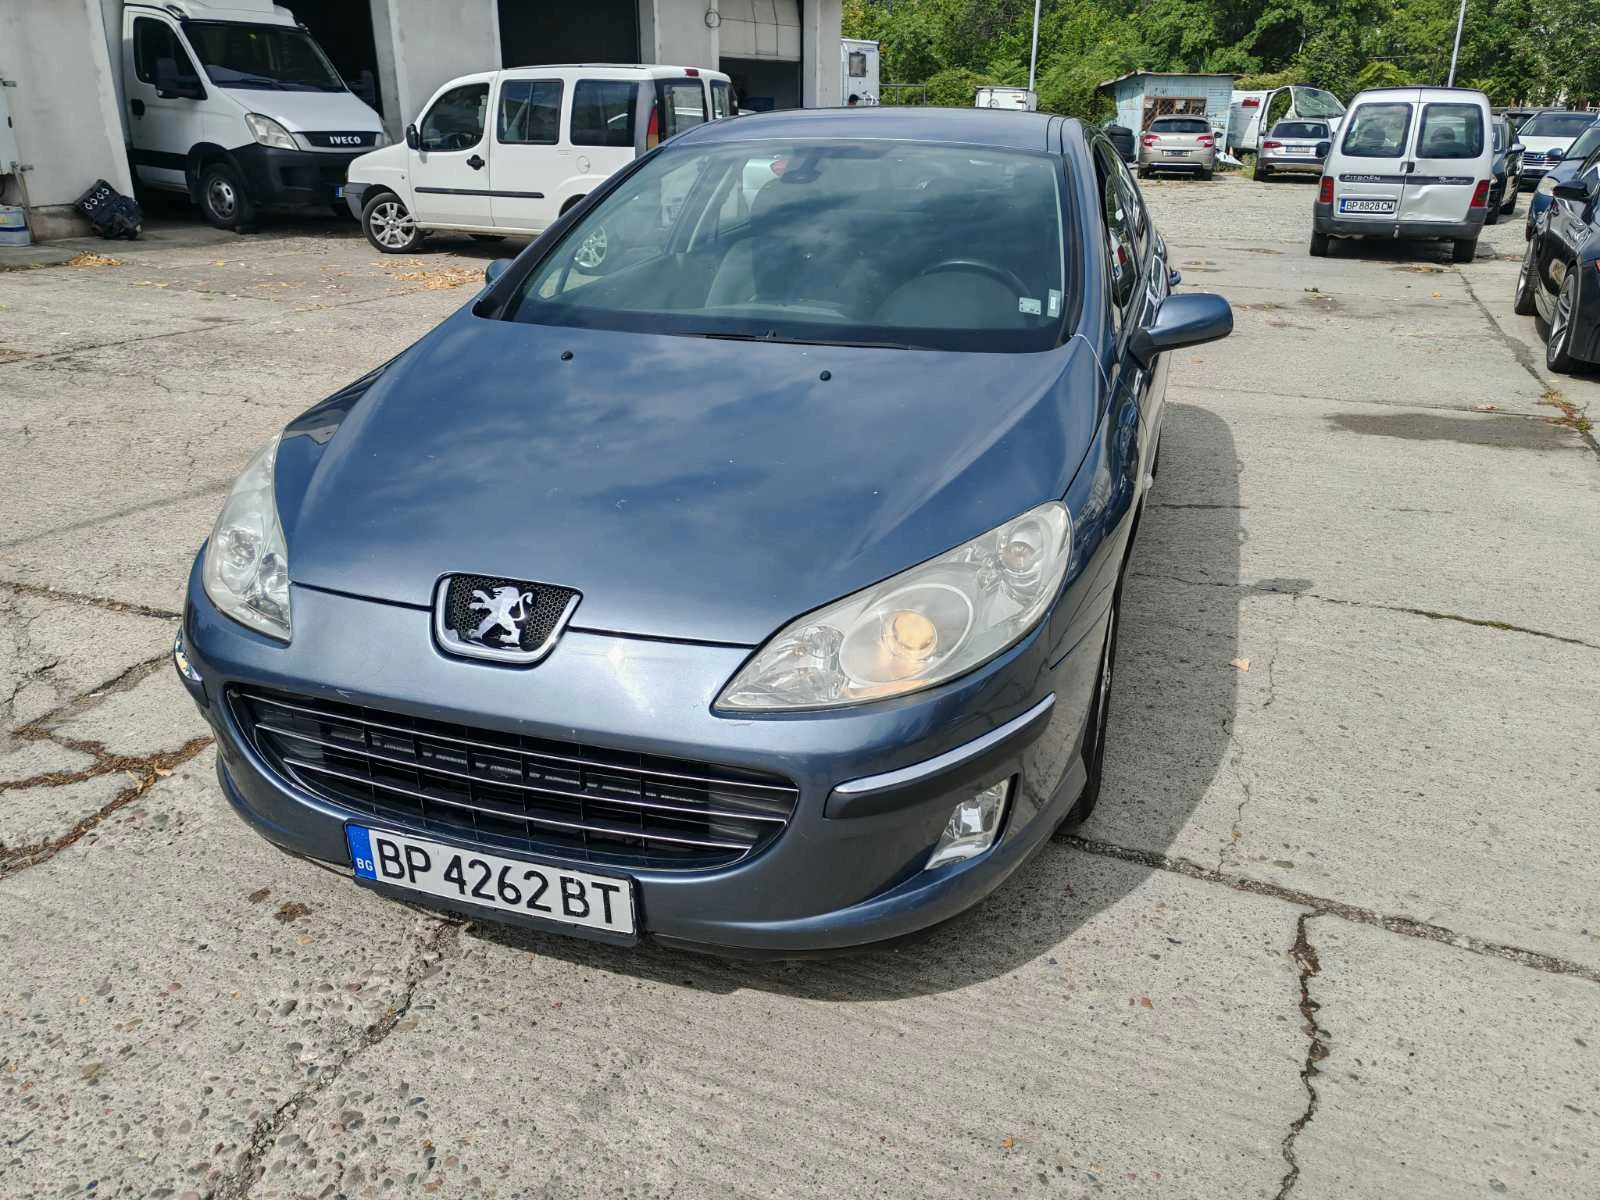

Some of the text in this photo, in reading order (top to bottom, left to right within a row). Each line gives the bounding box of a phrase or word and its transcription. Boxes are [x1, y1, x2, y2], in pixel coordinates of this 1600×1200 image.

[329, 136, 361, 144] IVECO
[1346, 201, 1358, 211] BP
[356, 858, 374, 872] BG
[376, 838, 620, 924] BP 4262 BT
